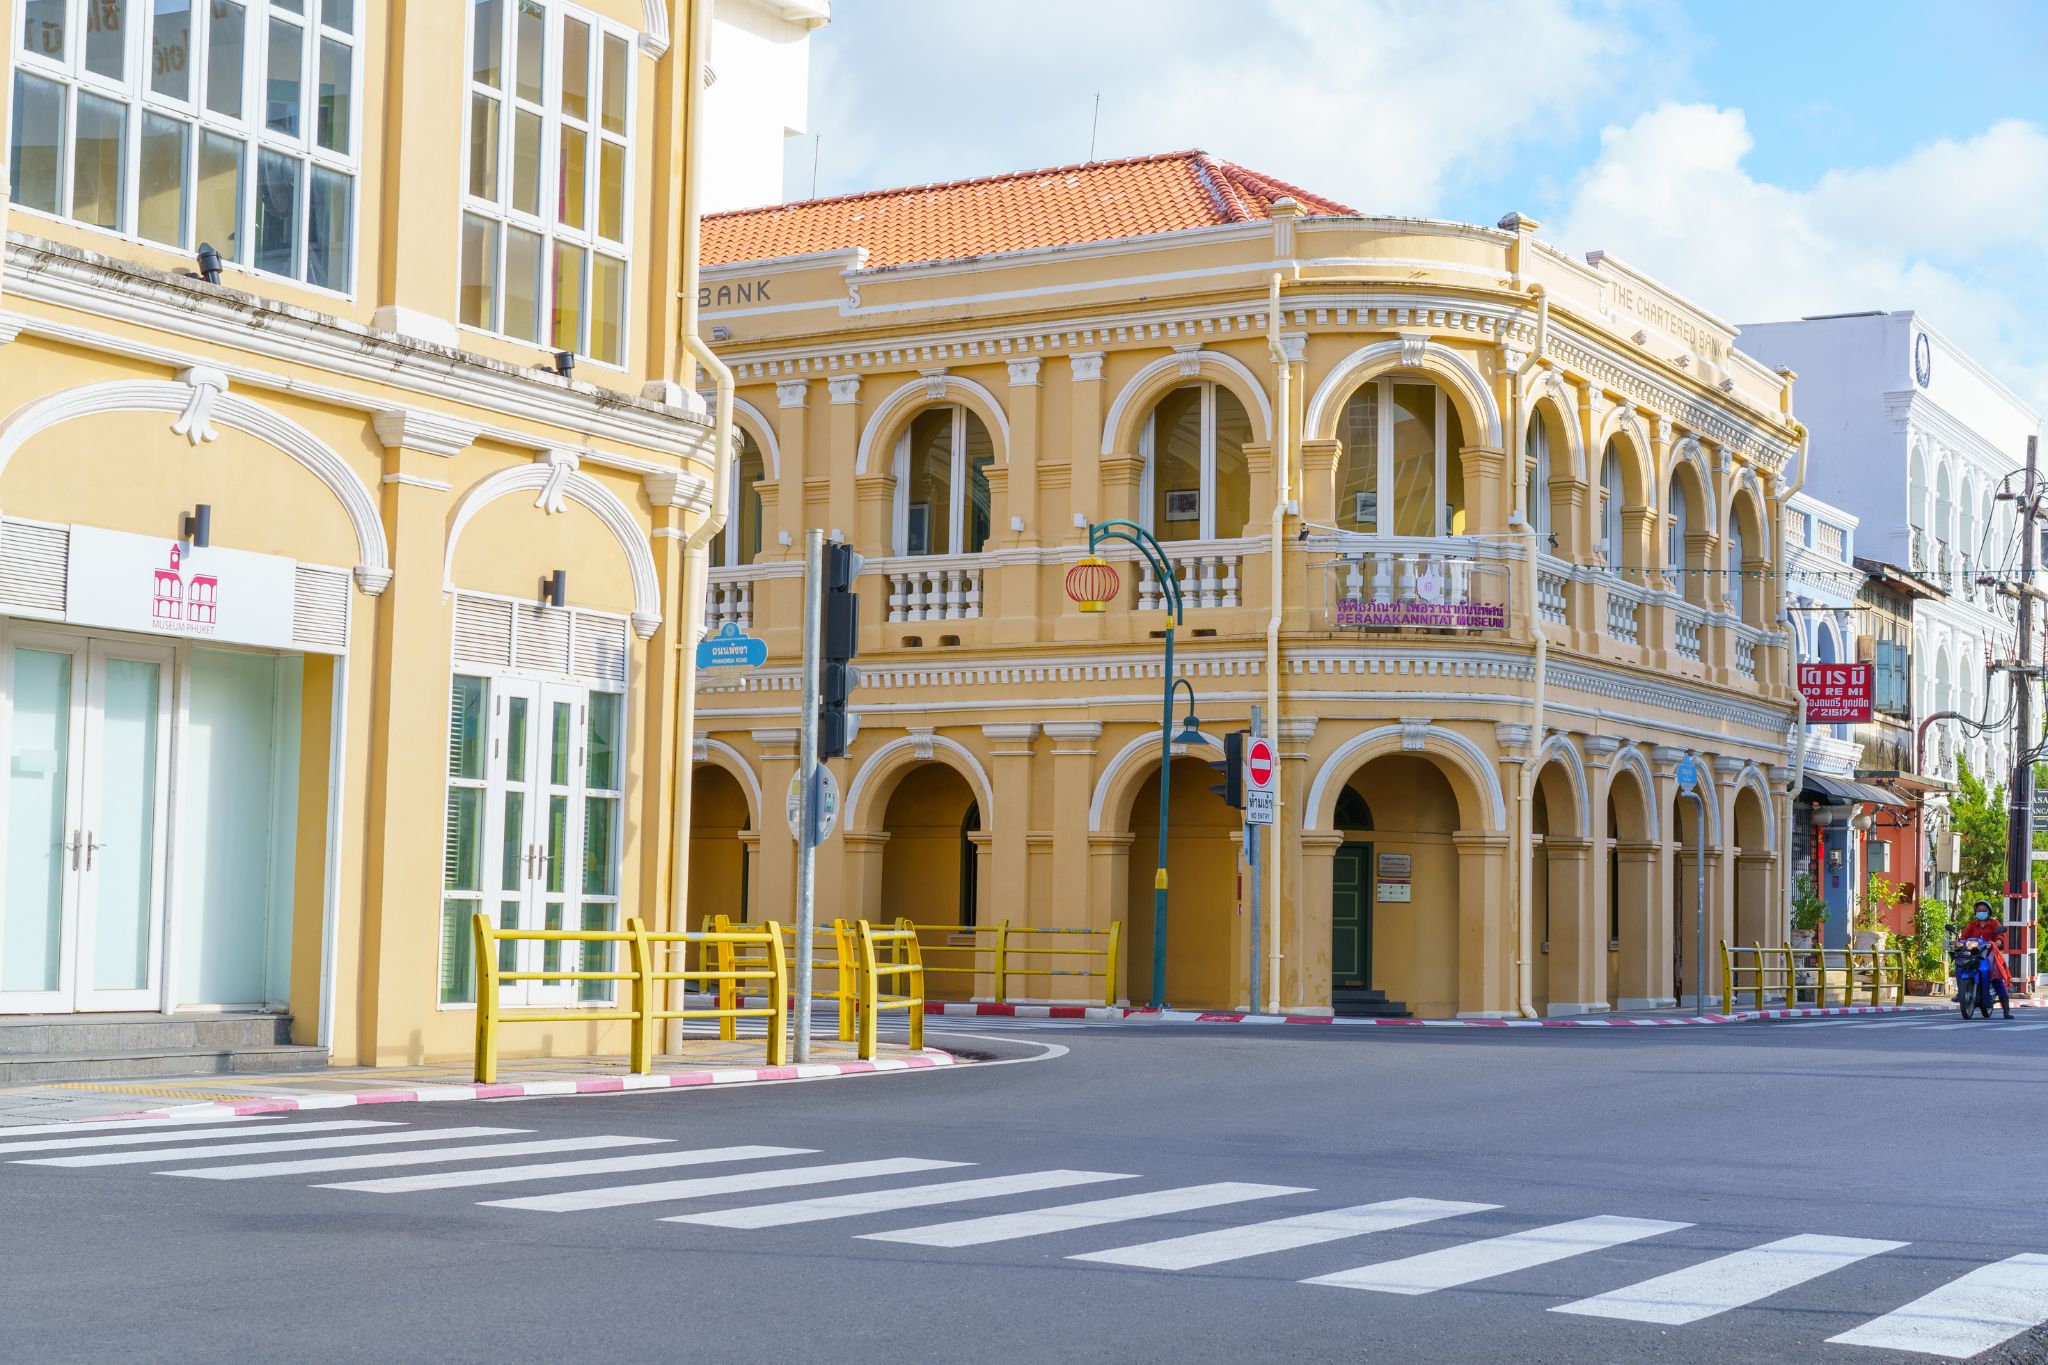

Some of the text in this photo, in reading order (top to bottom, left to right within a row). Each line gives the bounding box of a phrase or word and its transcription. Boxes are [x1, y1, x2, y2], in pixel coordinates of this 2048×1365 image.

[698, 280, 771, 307] BANK
[1612, 281, 1724, 359] THE CHARTERED BANK
[152, 619, 215, 635] MUSEUM PHUKET
[1336, 613, 1504, 628] PERANAKANNITAT MUSEUM
[1802, 687, 1864, 696] DO RE MI
[1820, 708, 1859, 717] 215174
[1249, 792, 1273, 809] ห้ามเข้า
